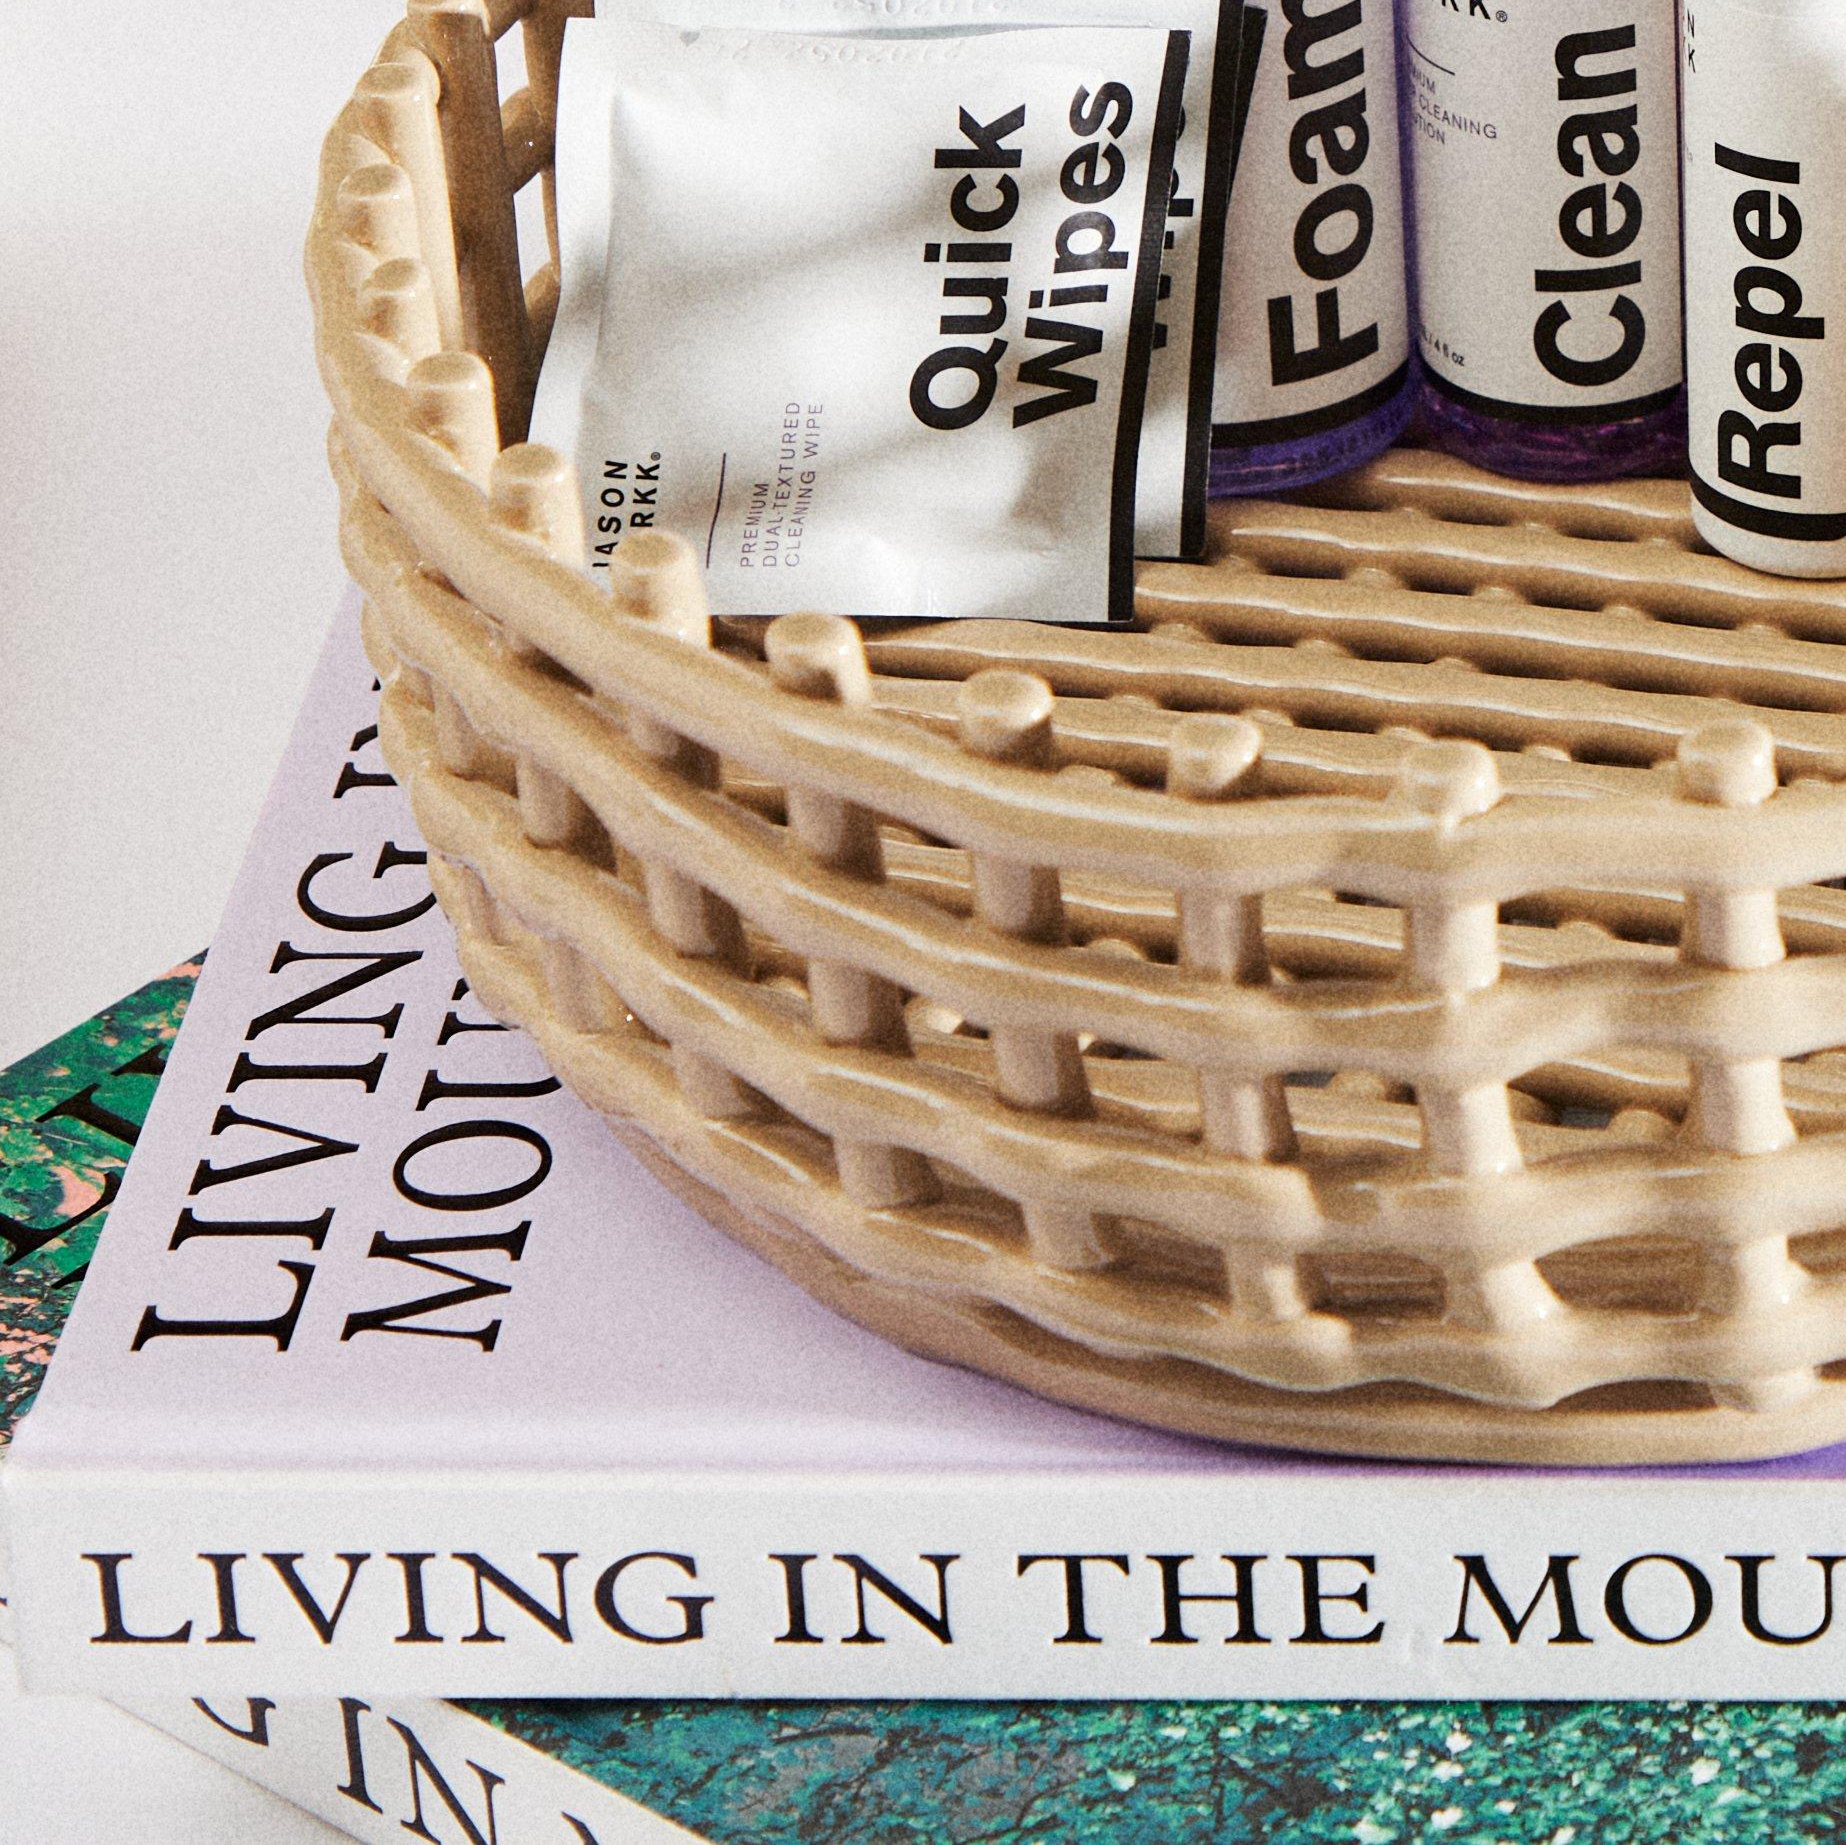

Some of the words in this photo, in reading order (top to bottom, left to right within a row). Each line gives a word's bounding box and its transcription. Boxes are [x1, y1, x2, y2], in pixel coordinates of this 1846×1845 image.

[1418, 94, 1498, 140] CLEANING
[909, 104, 1026, 431] Quick
[1012, 81, 1134, 429] Wipes
[1534, 24, 1646, 387] Clean
[1714, 142, 1826, 500] Repel
[739, 482, 770, 568] PREMIUM
[762, 401, 801, 568] DUAL-TEXTURED
[784, 470, 817, 568] CLEANING
[802, 403, 824, 459] WIPE
[130, 840, 439, 1353] LIVING
[81, 1552, 715, 1645] LIVING
[768, 1553, 961, 1645] IN
[1017, 1553, 1386, 1645] THE
[336, 1697, 506, 1845] IN
